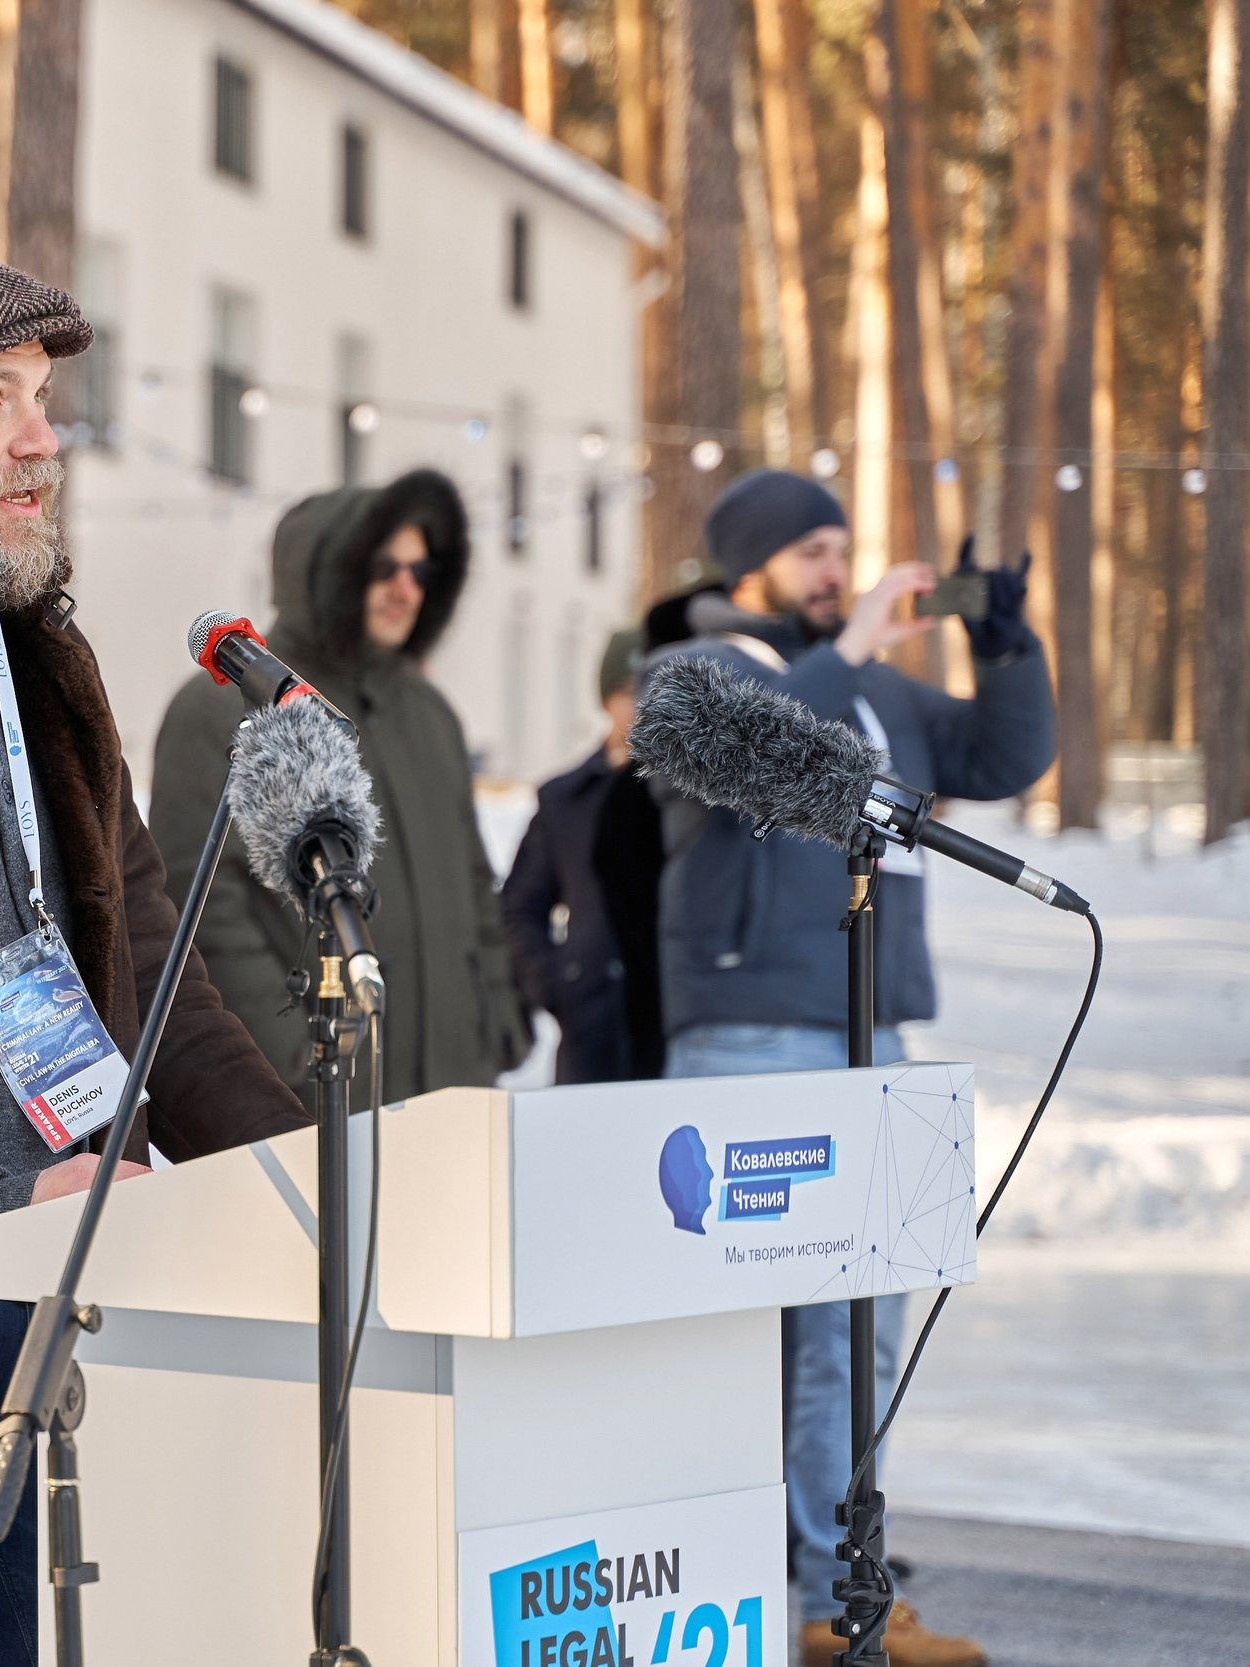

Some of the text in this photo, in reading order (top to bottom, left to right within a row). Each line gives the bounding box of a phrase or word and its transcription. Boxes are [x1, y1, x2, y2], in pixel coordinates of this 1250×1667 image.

[873, 794, 897, 808] BOYA
[19, 800, 34, 838] LOYS
[0, 1031, 30, 1051] CRIMINAL
[48, 1012, 64, 1024] NEW
[62, 1000, 84, 1016] REALITY
[19, 1037, 99, 1086] CIVIL LAW IN THE DIGITAL ERA
[48, 1084, 79, 1106] DENIS
[56, 1086, 104, 1118] PUCHKOV
[30, 1101, 62, 1141] SPEAKER
[77, 1106, 94, 1118] Russia
[731, 1148, 826, 1171] Ковалевские
[733, 1189, 785, 1210] Чтения
[725, 1234, 854, 1265] Мы творим историю!
[521, 1547, 680, 1620] RUSSIAN
[521, 1622, 634, 1667] LEGAL
